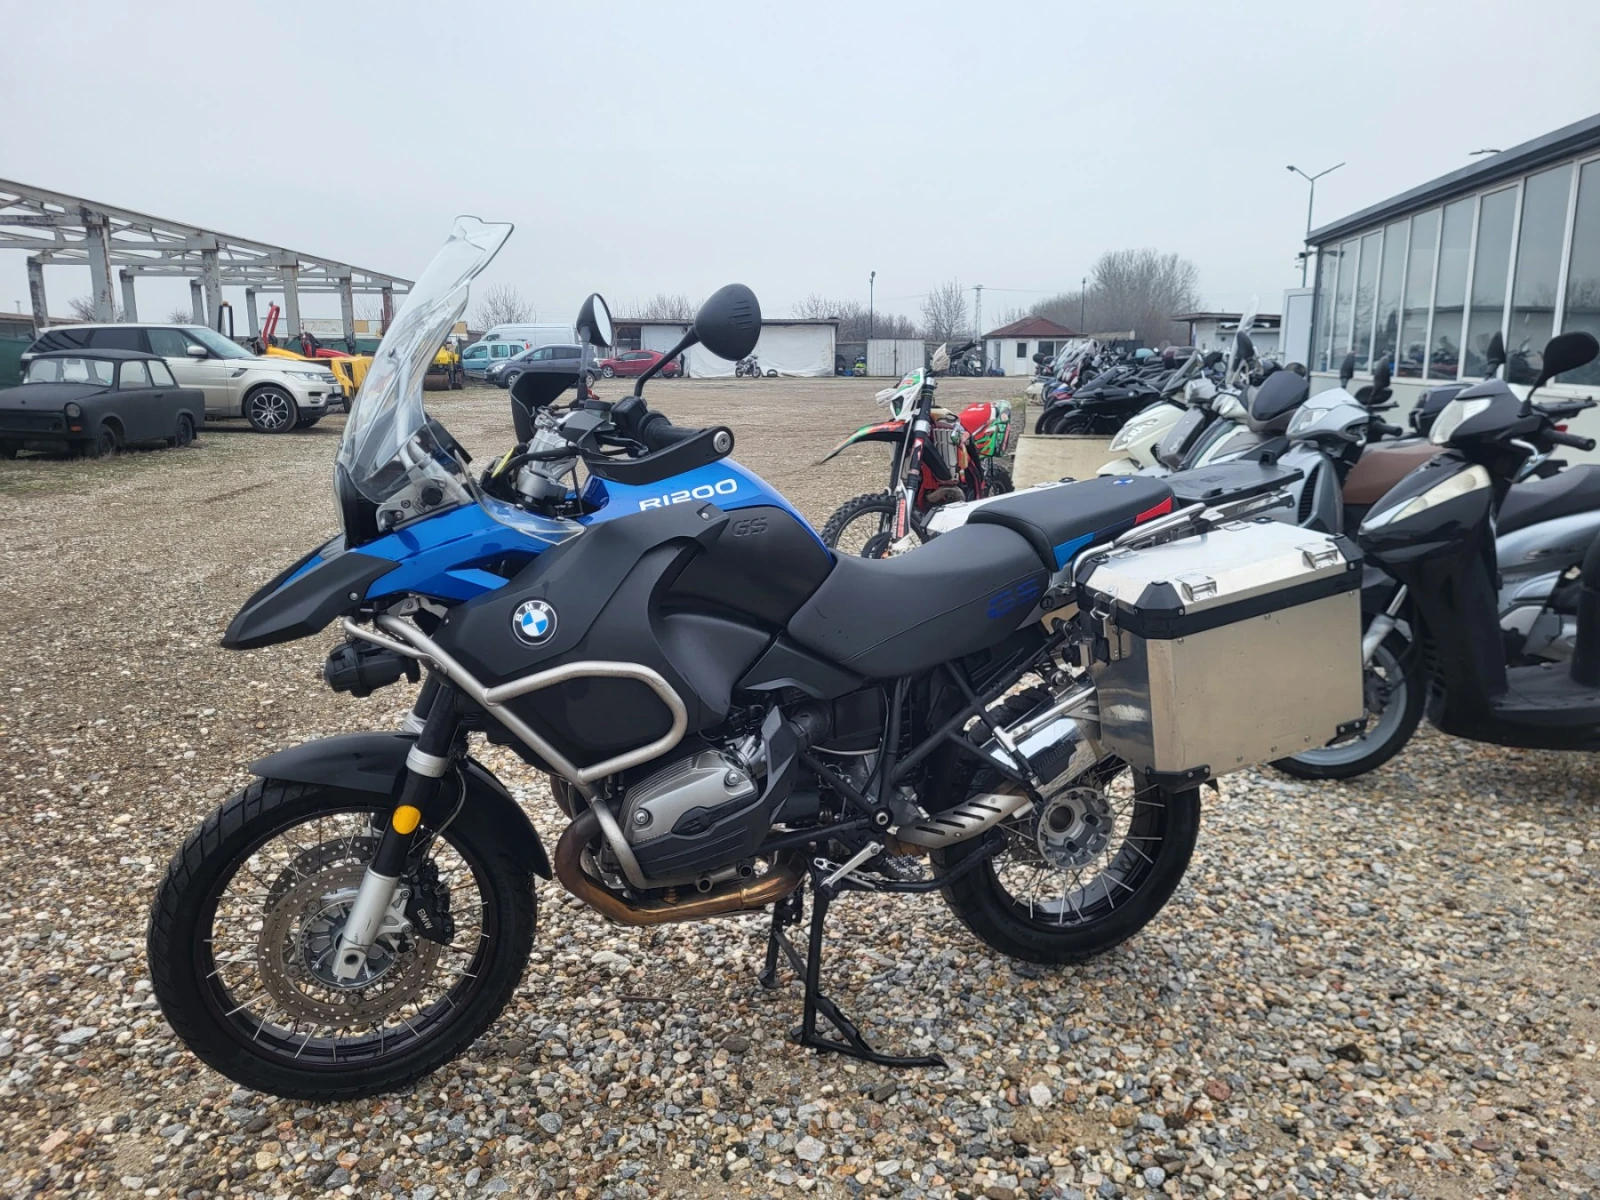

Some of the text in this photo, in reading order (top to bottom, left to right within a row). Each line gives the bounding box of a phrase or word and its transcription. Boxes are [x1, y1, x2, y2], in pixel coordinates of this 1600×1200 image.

[638, 478, 738, 511] R1200
[732, 517, 769, 537] GS
[986, 578, 1039, 619] GS
[514, 602, 549, 622] BMW
[416, 908, 433, 929] BMW
